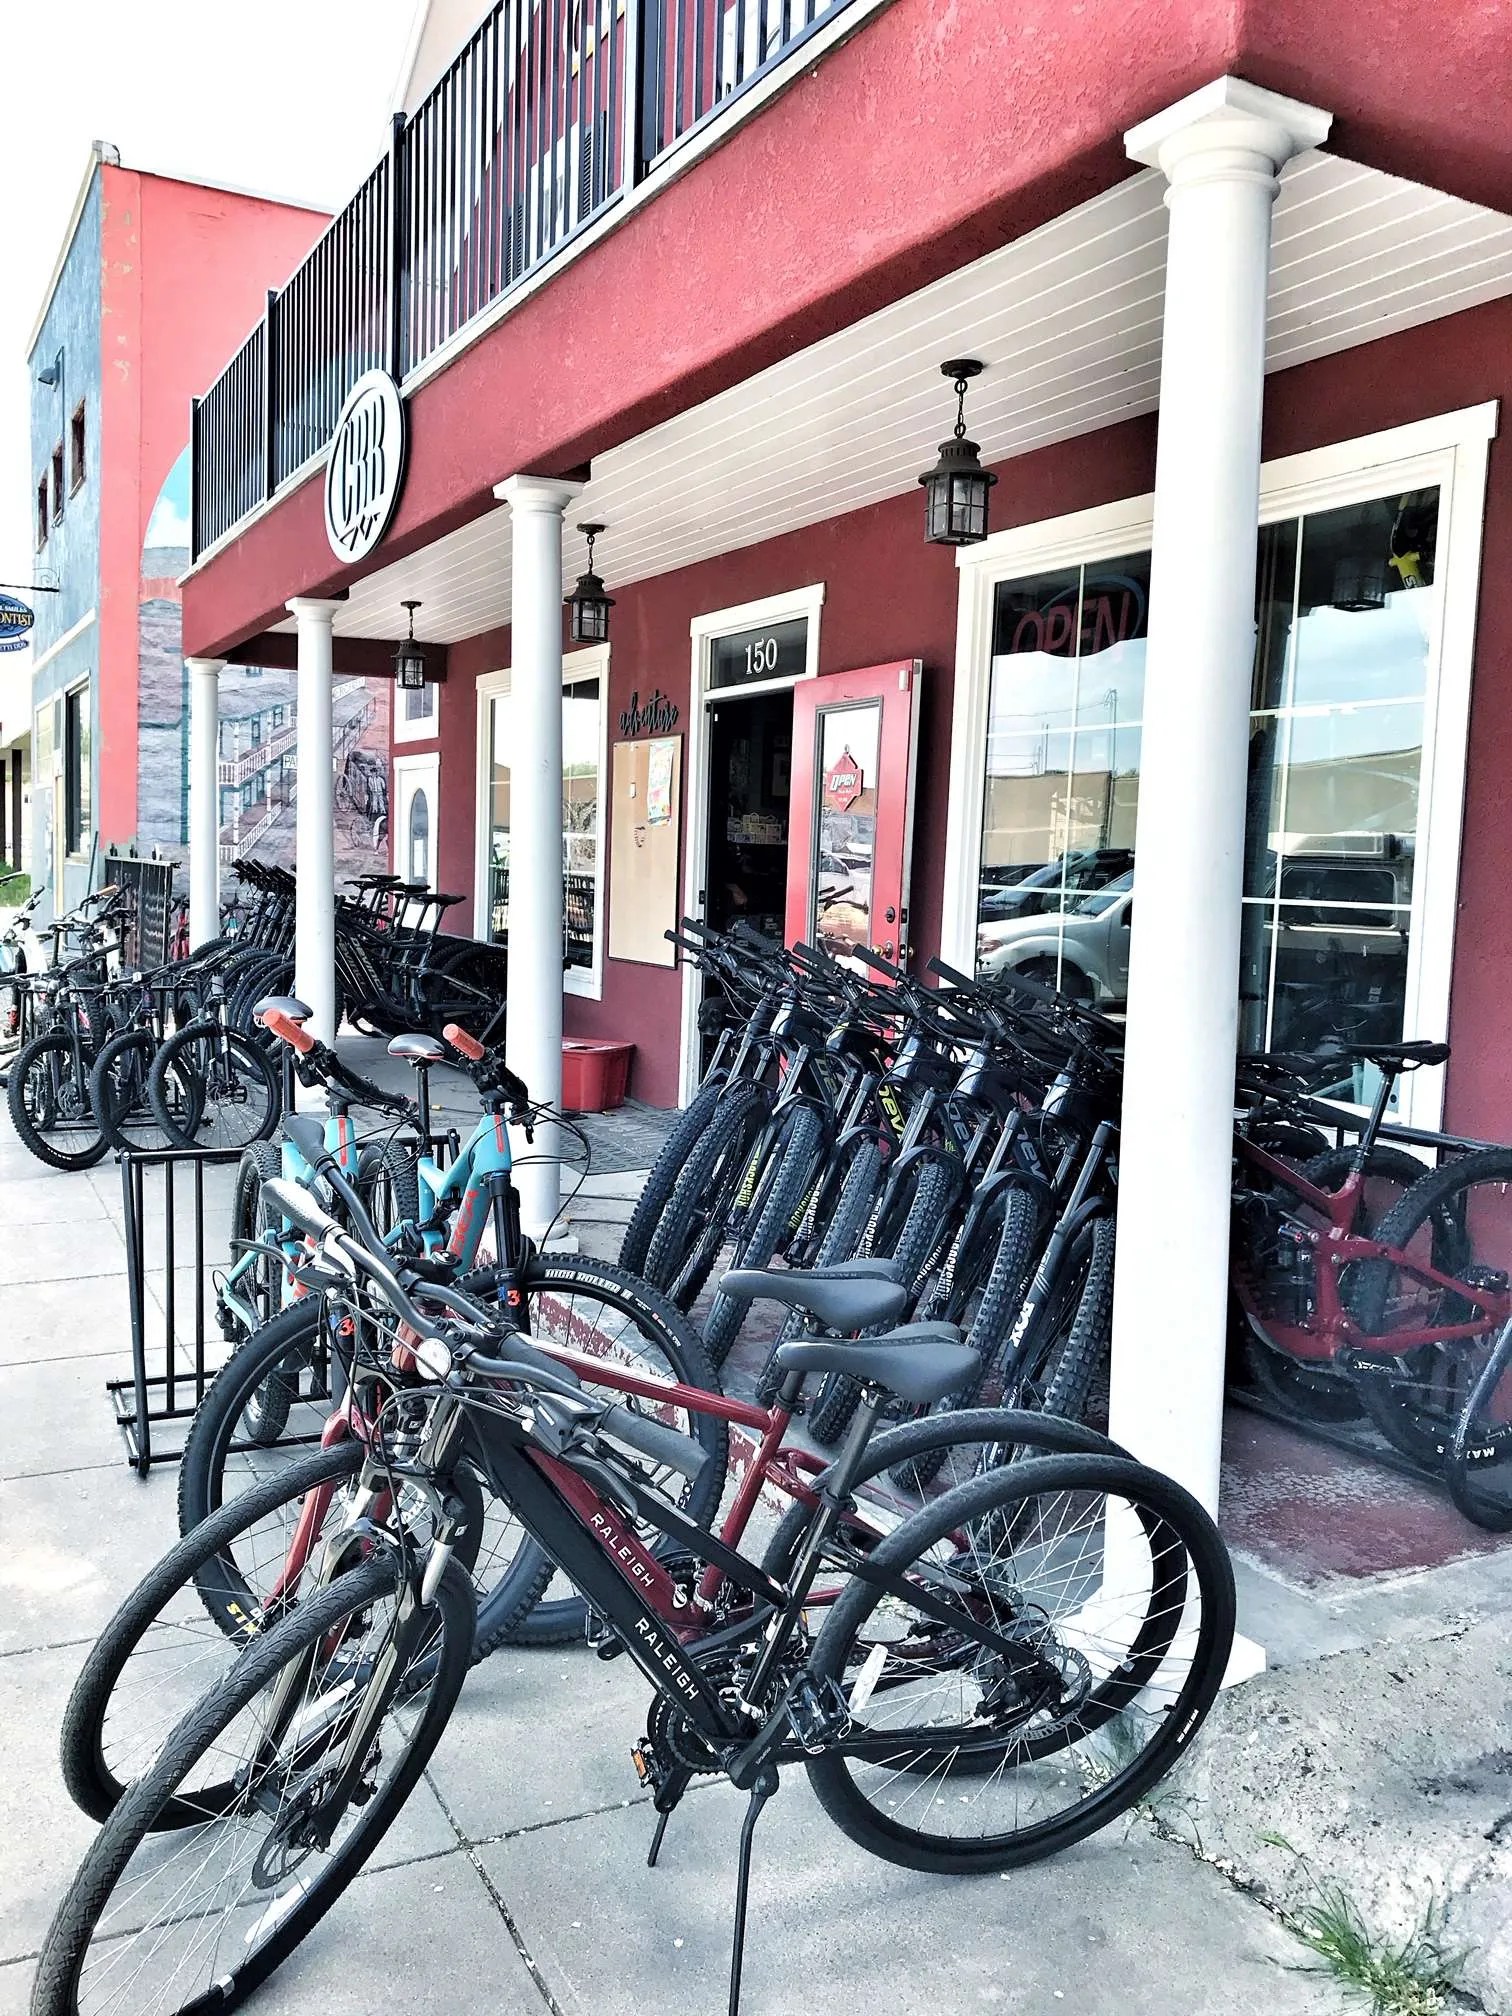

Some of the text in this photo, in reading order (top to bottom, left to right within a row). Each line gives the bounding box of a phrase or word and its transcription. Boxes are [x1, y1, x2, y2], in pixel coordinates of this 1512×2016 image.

[1011, 591, 1131, 657] OPEN
[745, 637, 778, 675] 150
[830, 774, 857, 792] OPEN
[576, 1271, 621, 1294] ROLLER
[1009, 1301, 1036, 1348] FOX
[590, 1513, 655, 1588] RALEIGH
[634, 1617, 699, 1701] RALEIGH
